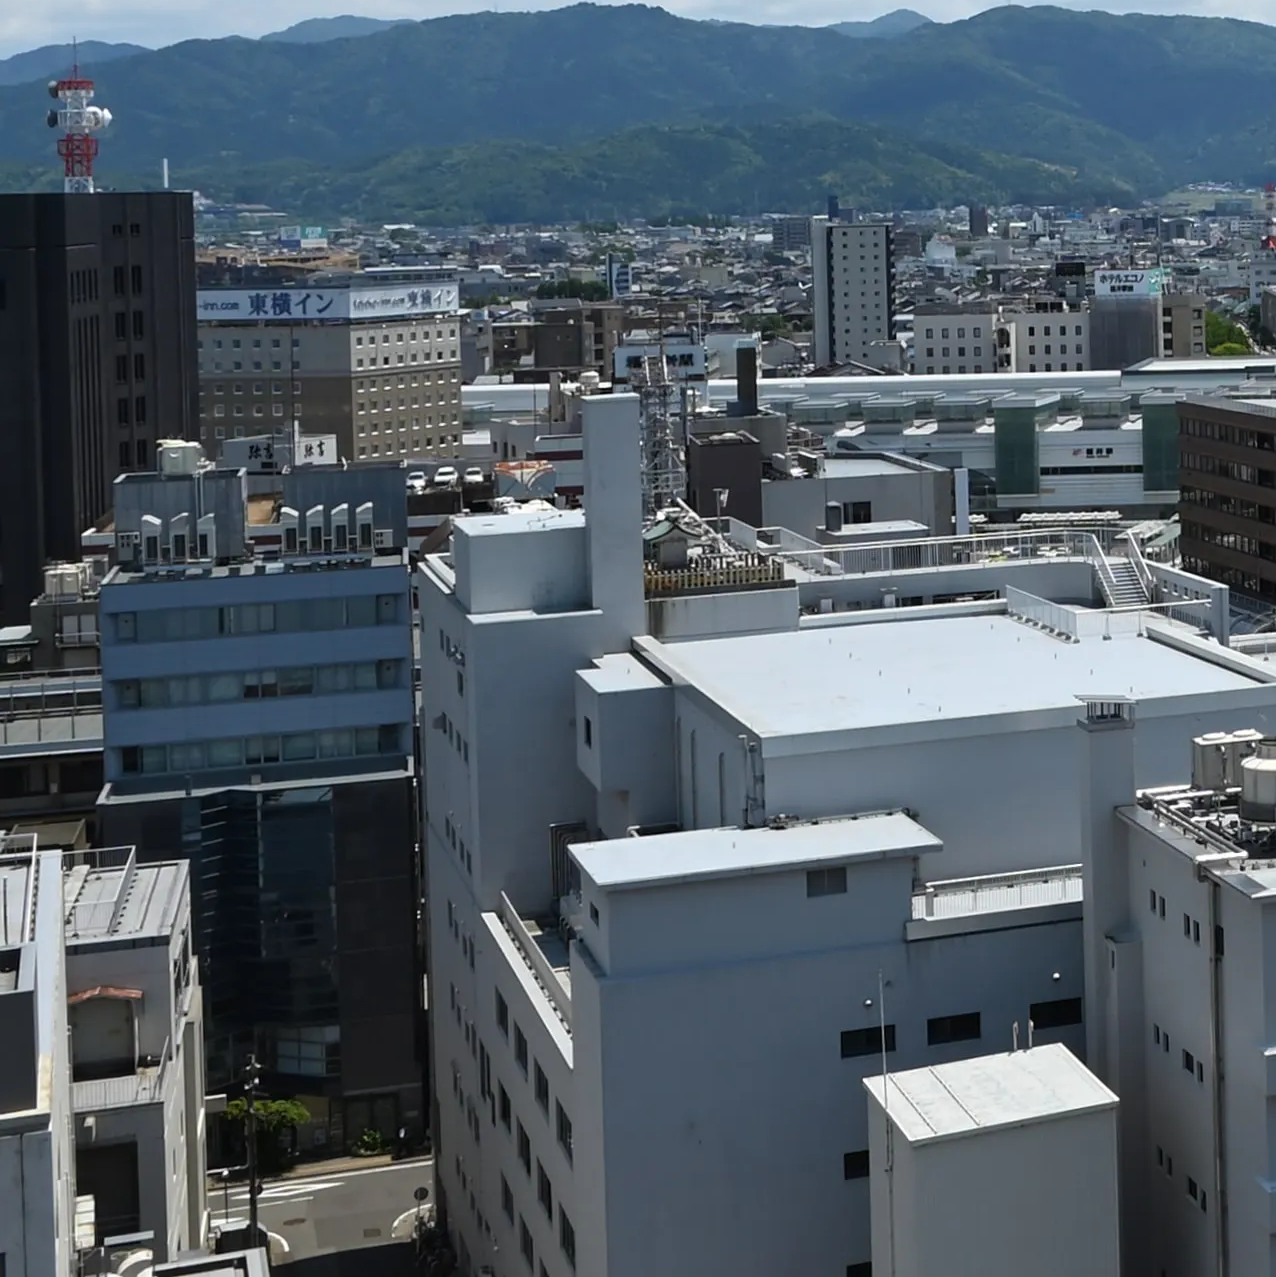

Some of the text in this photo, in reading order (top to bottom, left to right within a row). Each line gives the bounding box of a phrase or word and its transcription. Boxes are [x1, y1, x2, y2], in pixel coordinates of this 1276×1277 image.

[1100, 273, 1144, 284] ホテルエコノ
[248, 293, 334, 316] 東横イン
[407, 288, 457, 310] 東横イン
